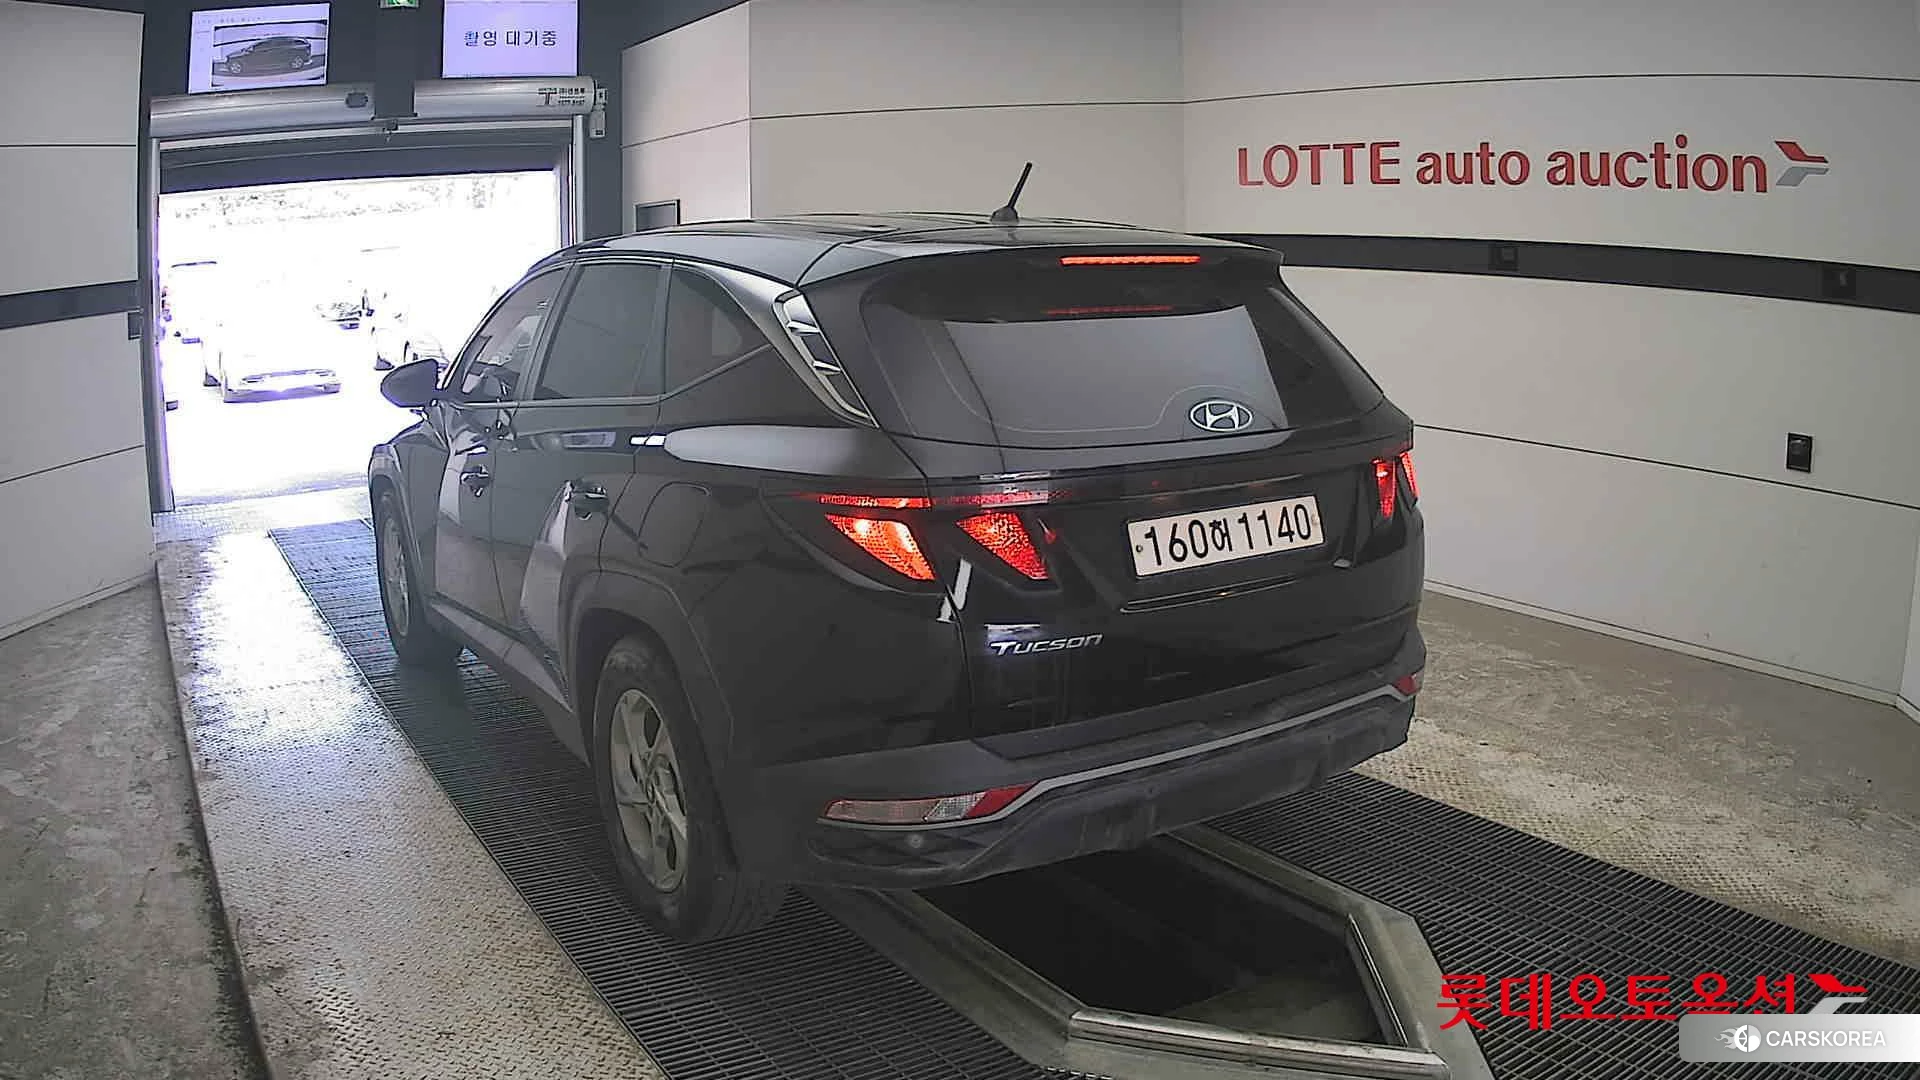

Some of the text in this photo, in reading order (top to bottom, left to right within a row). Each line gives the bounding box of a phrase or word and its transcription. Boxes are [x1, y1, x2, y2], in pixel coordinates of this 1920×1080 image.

[505, 30, 557, 47] 대기중
[1238, 134, 1767, 193] LOTTE auto auction
